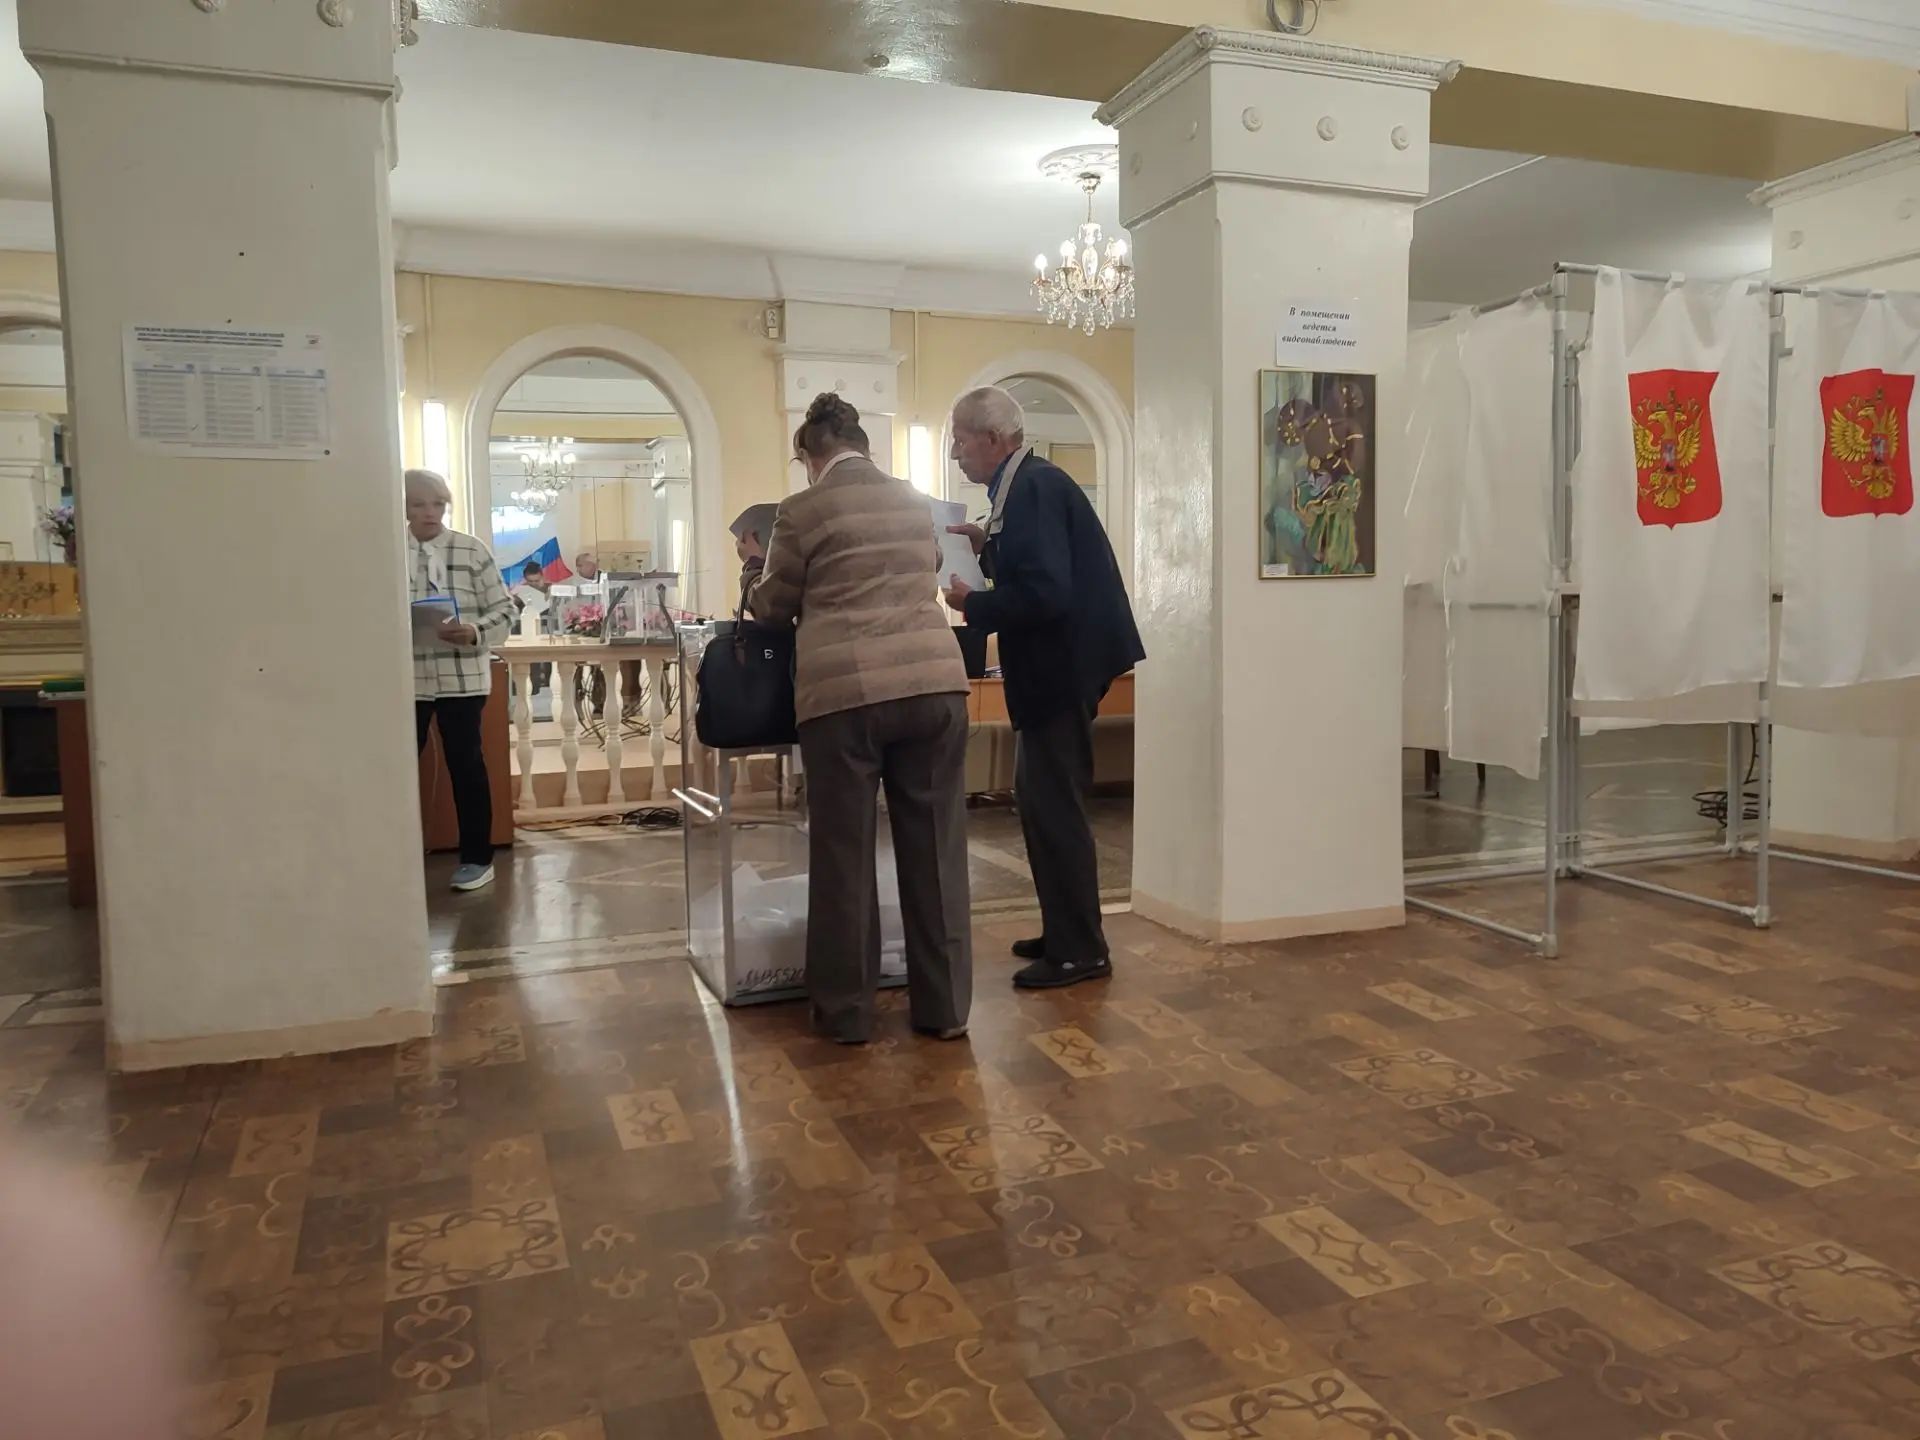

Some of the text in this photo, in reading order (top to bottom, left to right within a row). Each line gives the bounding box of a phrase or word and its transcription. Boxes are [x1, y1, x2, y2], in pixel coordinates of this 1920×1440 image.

[1289, 306, 1351, 320] В помещении
[1302, 322, 1337, 332] ведется
[1281, 335, 1357, 347] видеонаблюдение
